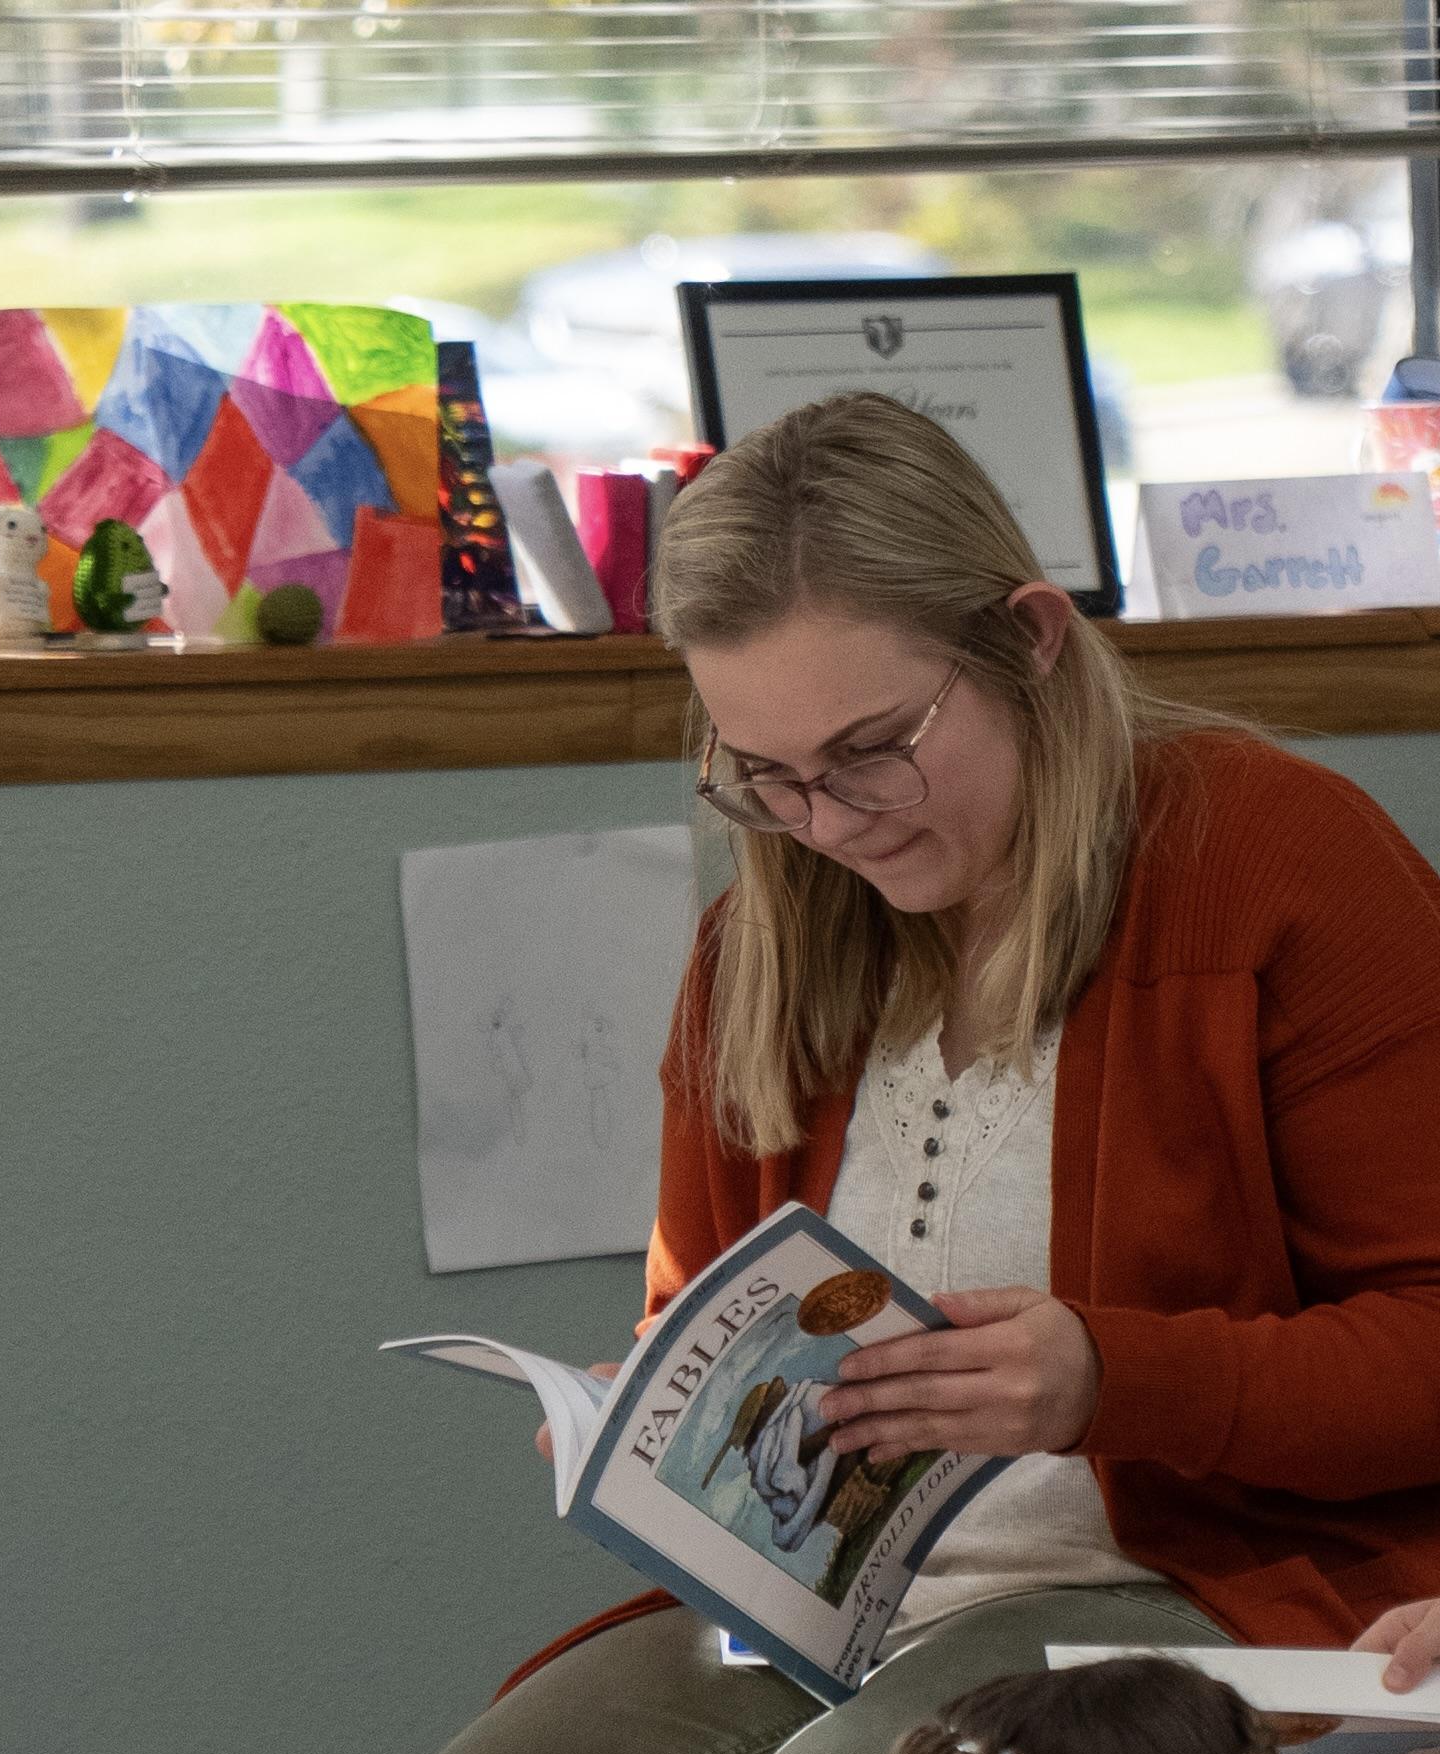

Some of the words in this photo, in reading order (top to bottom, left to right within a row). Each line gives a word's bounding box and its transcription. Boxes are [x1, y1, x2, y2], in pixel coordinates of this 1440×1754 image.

[1180, 488, 1289, 540] Mrs.
[1194, 546, 1367, 599] Garrett
[630, 1276, 780, 1470] FABLES
[851, 1504, 916, 1613] ARNOLD
[833, 1614, 867, 1676] Property
[864, 1594, 877, 1610] of
[843, 1646, 864, 1685] APEX
